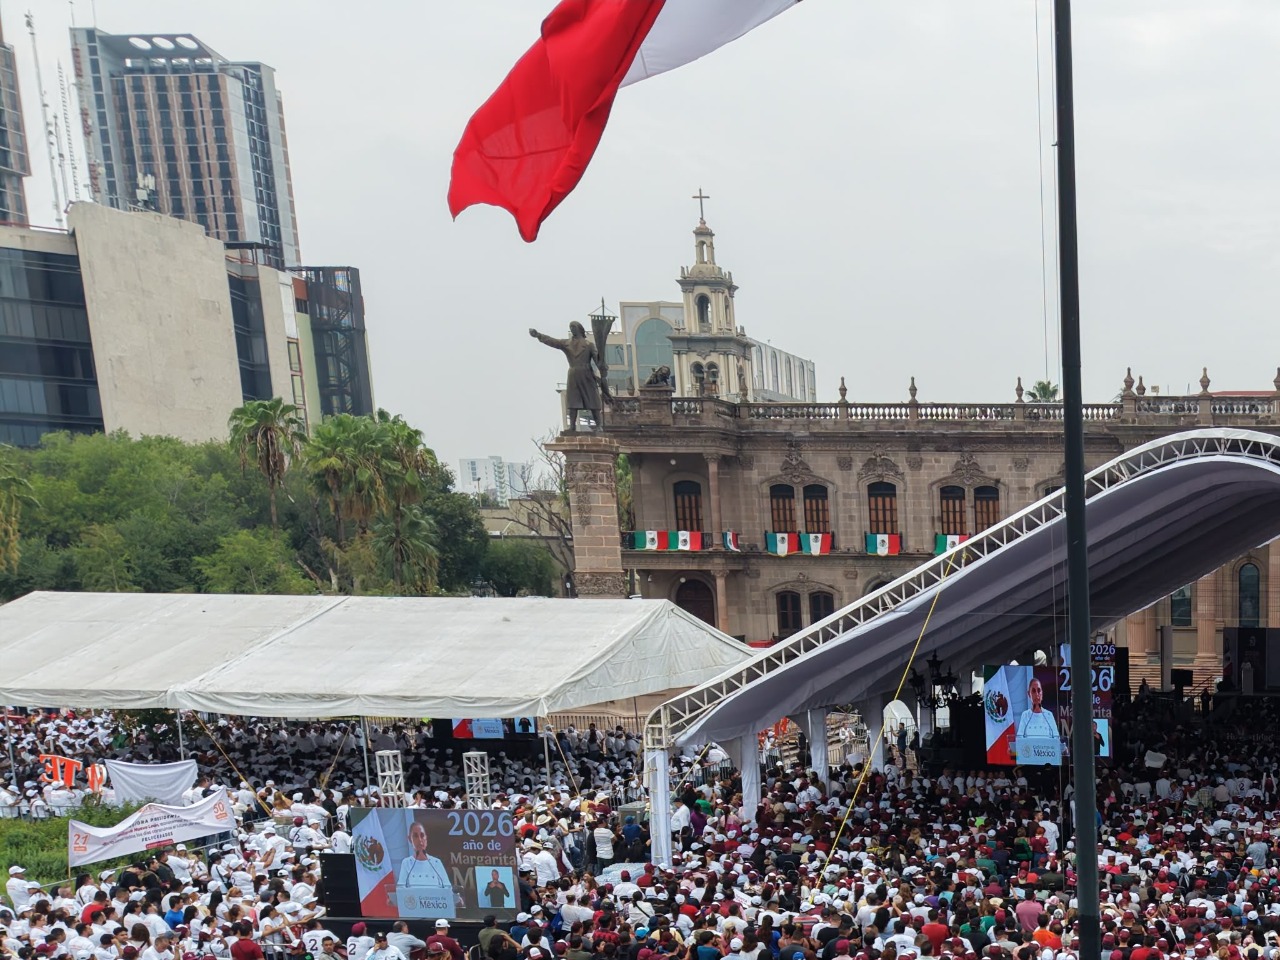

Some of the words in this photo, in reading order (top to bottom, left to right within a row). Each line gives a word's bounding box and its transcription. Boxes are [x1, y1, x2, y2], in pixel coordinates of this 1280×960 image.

[1059, 669, 1111, 692] 226
[1060, 706, 1112, 717] Marita
[447, 811, 514, 837] 2026
[463, 840, 484, 850] año
[487, 839, 501, 851] de
[450, 851, 517, 867] Margarita
[419, 900, 448, 909] México
[309, 939, 318, 951] 2
[348, 943, 356, 955] 2
